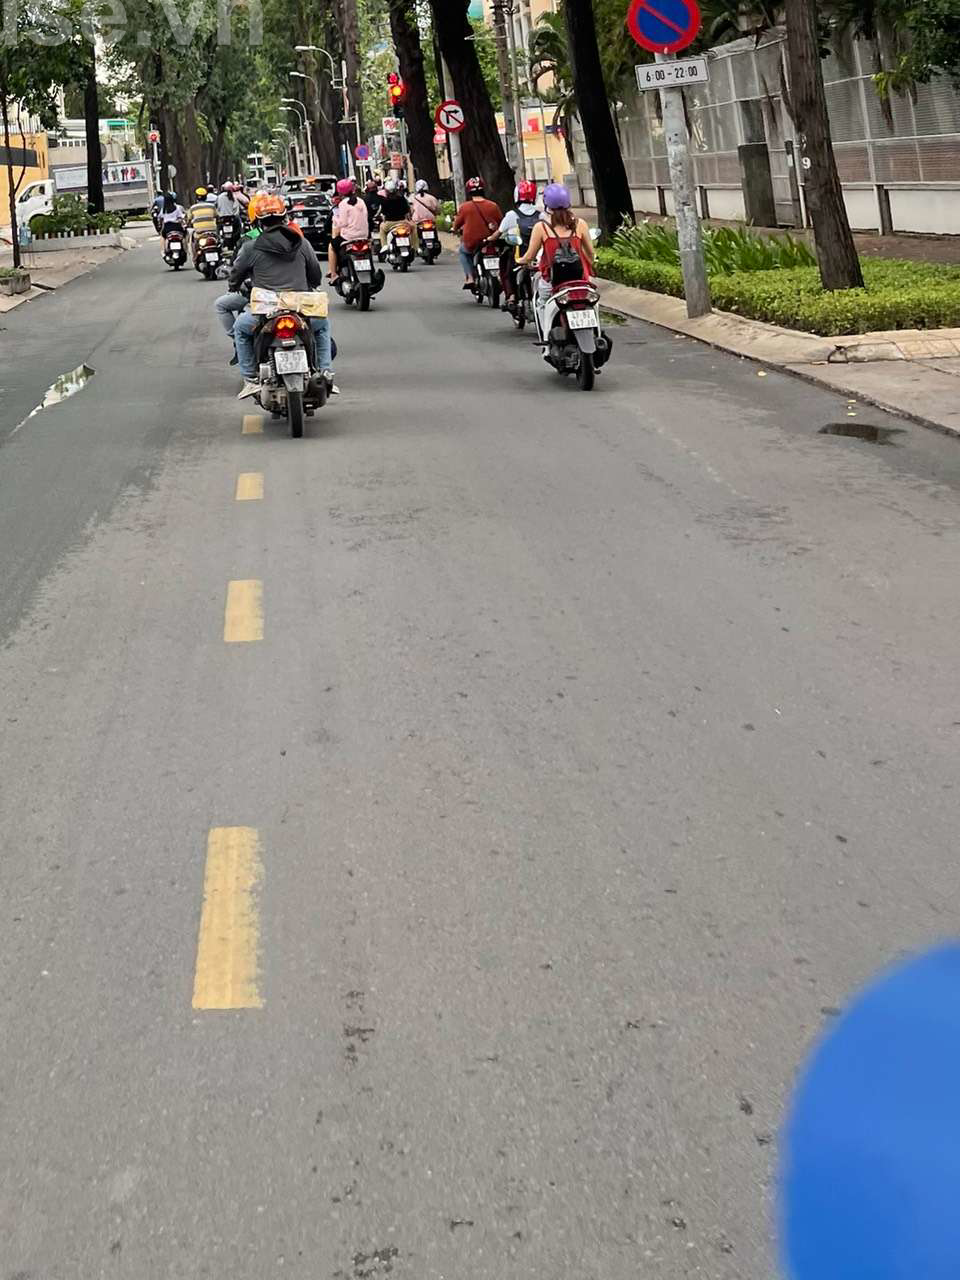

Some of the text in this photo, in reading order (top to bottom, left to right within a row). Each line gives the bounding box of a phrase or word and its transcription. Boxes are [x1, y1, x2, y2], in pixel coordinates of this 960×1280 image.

[646, 70, 665, 82] 6:00
[674, 66, 698, 78] 22:00
[802, 157, 811, 169] 9
